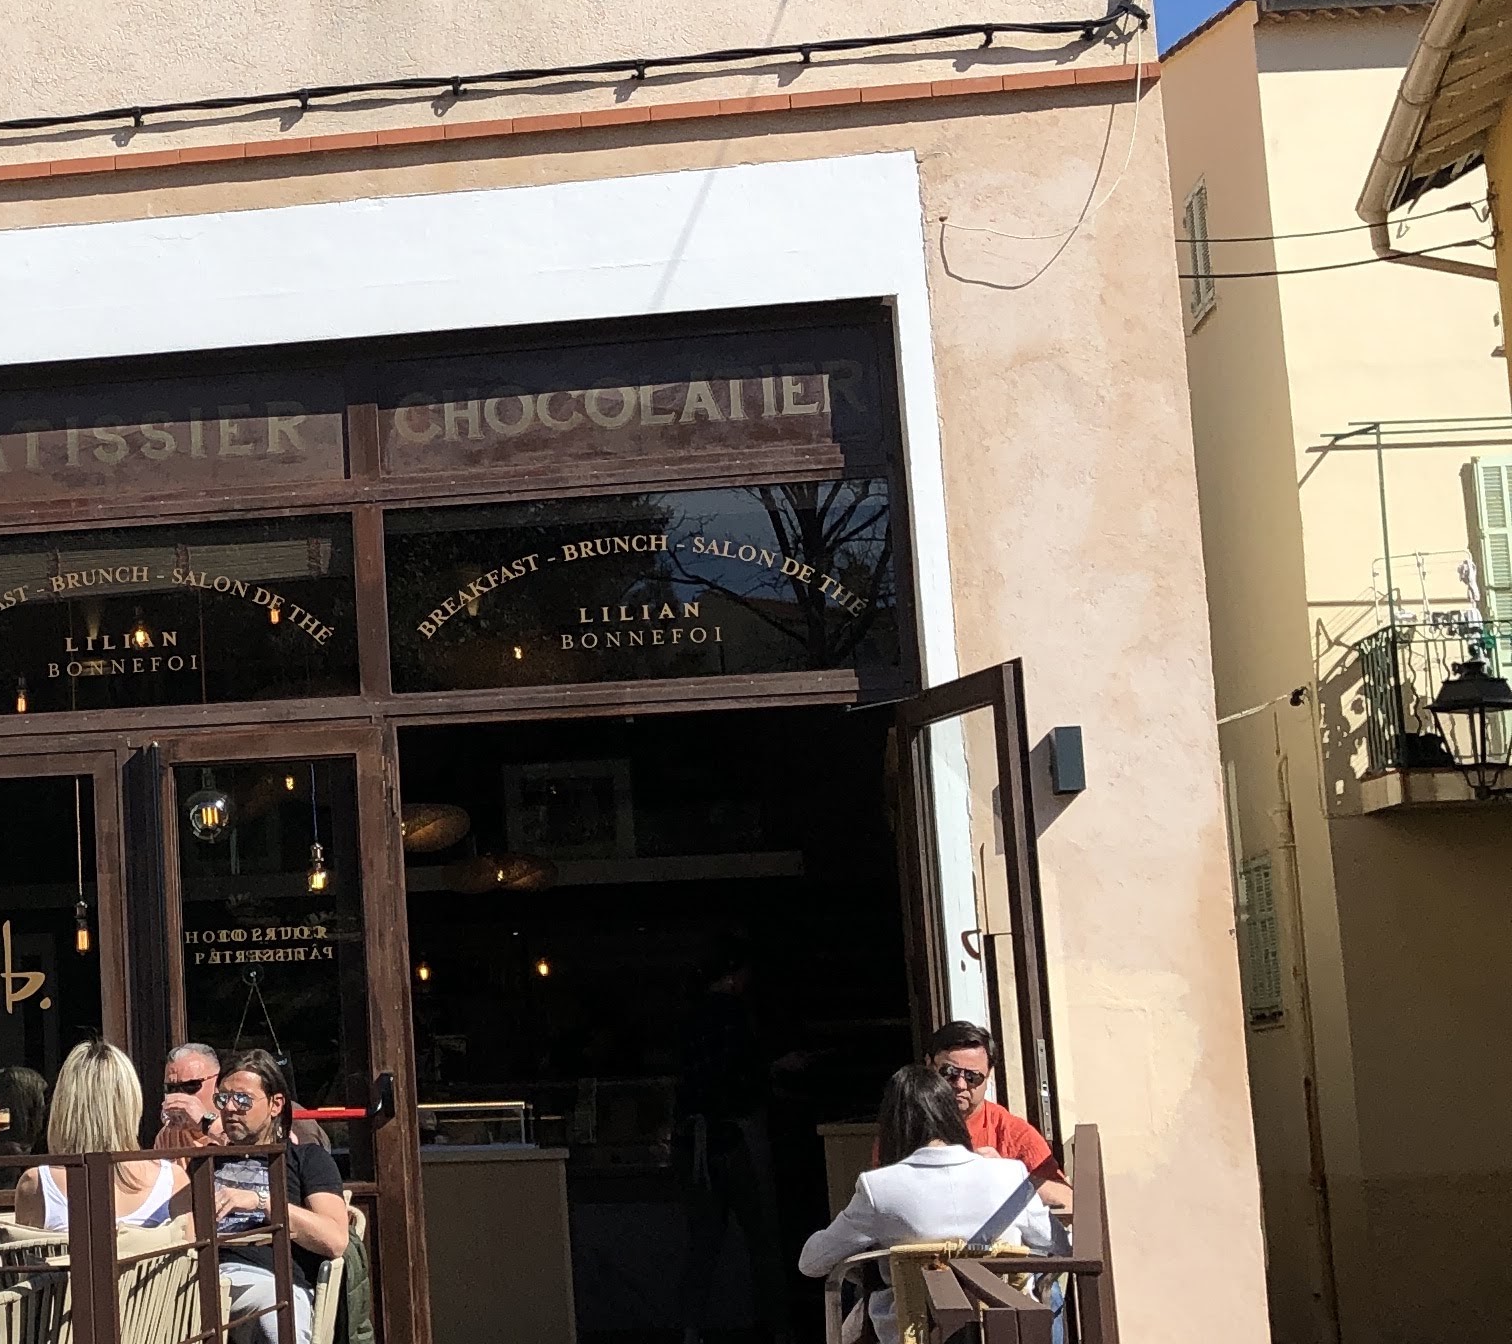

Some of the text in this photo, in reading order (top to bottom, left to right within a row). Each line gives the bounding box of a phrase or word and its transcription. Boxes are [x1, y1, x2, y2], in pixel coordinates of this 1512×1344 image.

[416, 554, 539, 639] BREAKFAST
[561, 534, 669, 562] BRUNCH
[692, 536, 777, 568] SALON
[780, 556, 815, 584] DE
[817, 573, 870, 617] THÉ
[49, 566, 149, 593] BRUNCH
[171, 568, 251, 598] SALON
[251, 587, 285, 613] DE
[288, 604, 335, 645] THÉ
[579, 602, 700, 624] LILIAN
[65, 630, 178, 652] LILIAN
[560, 626, 723, 650] BONNEFOI
[47, 654, 198, 678] BONNEFOI
